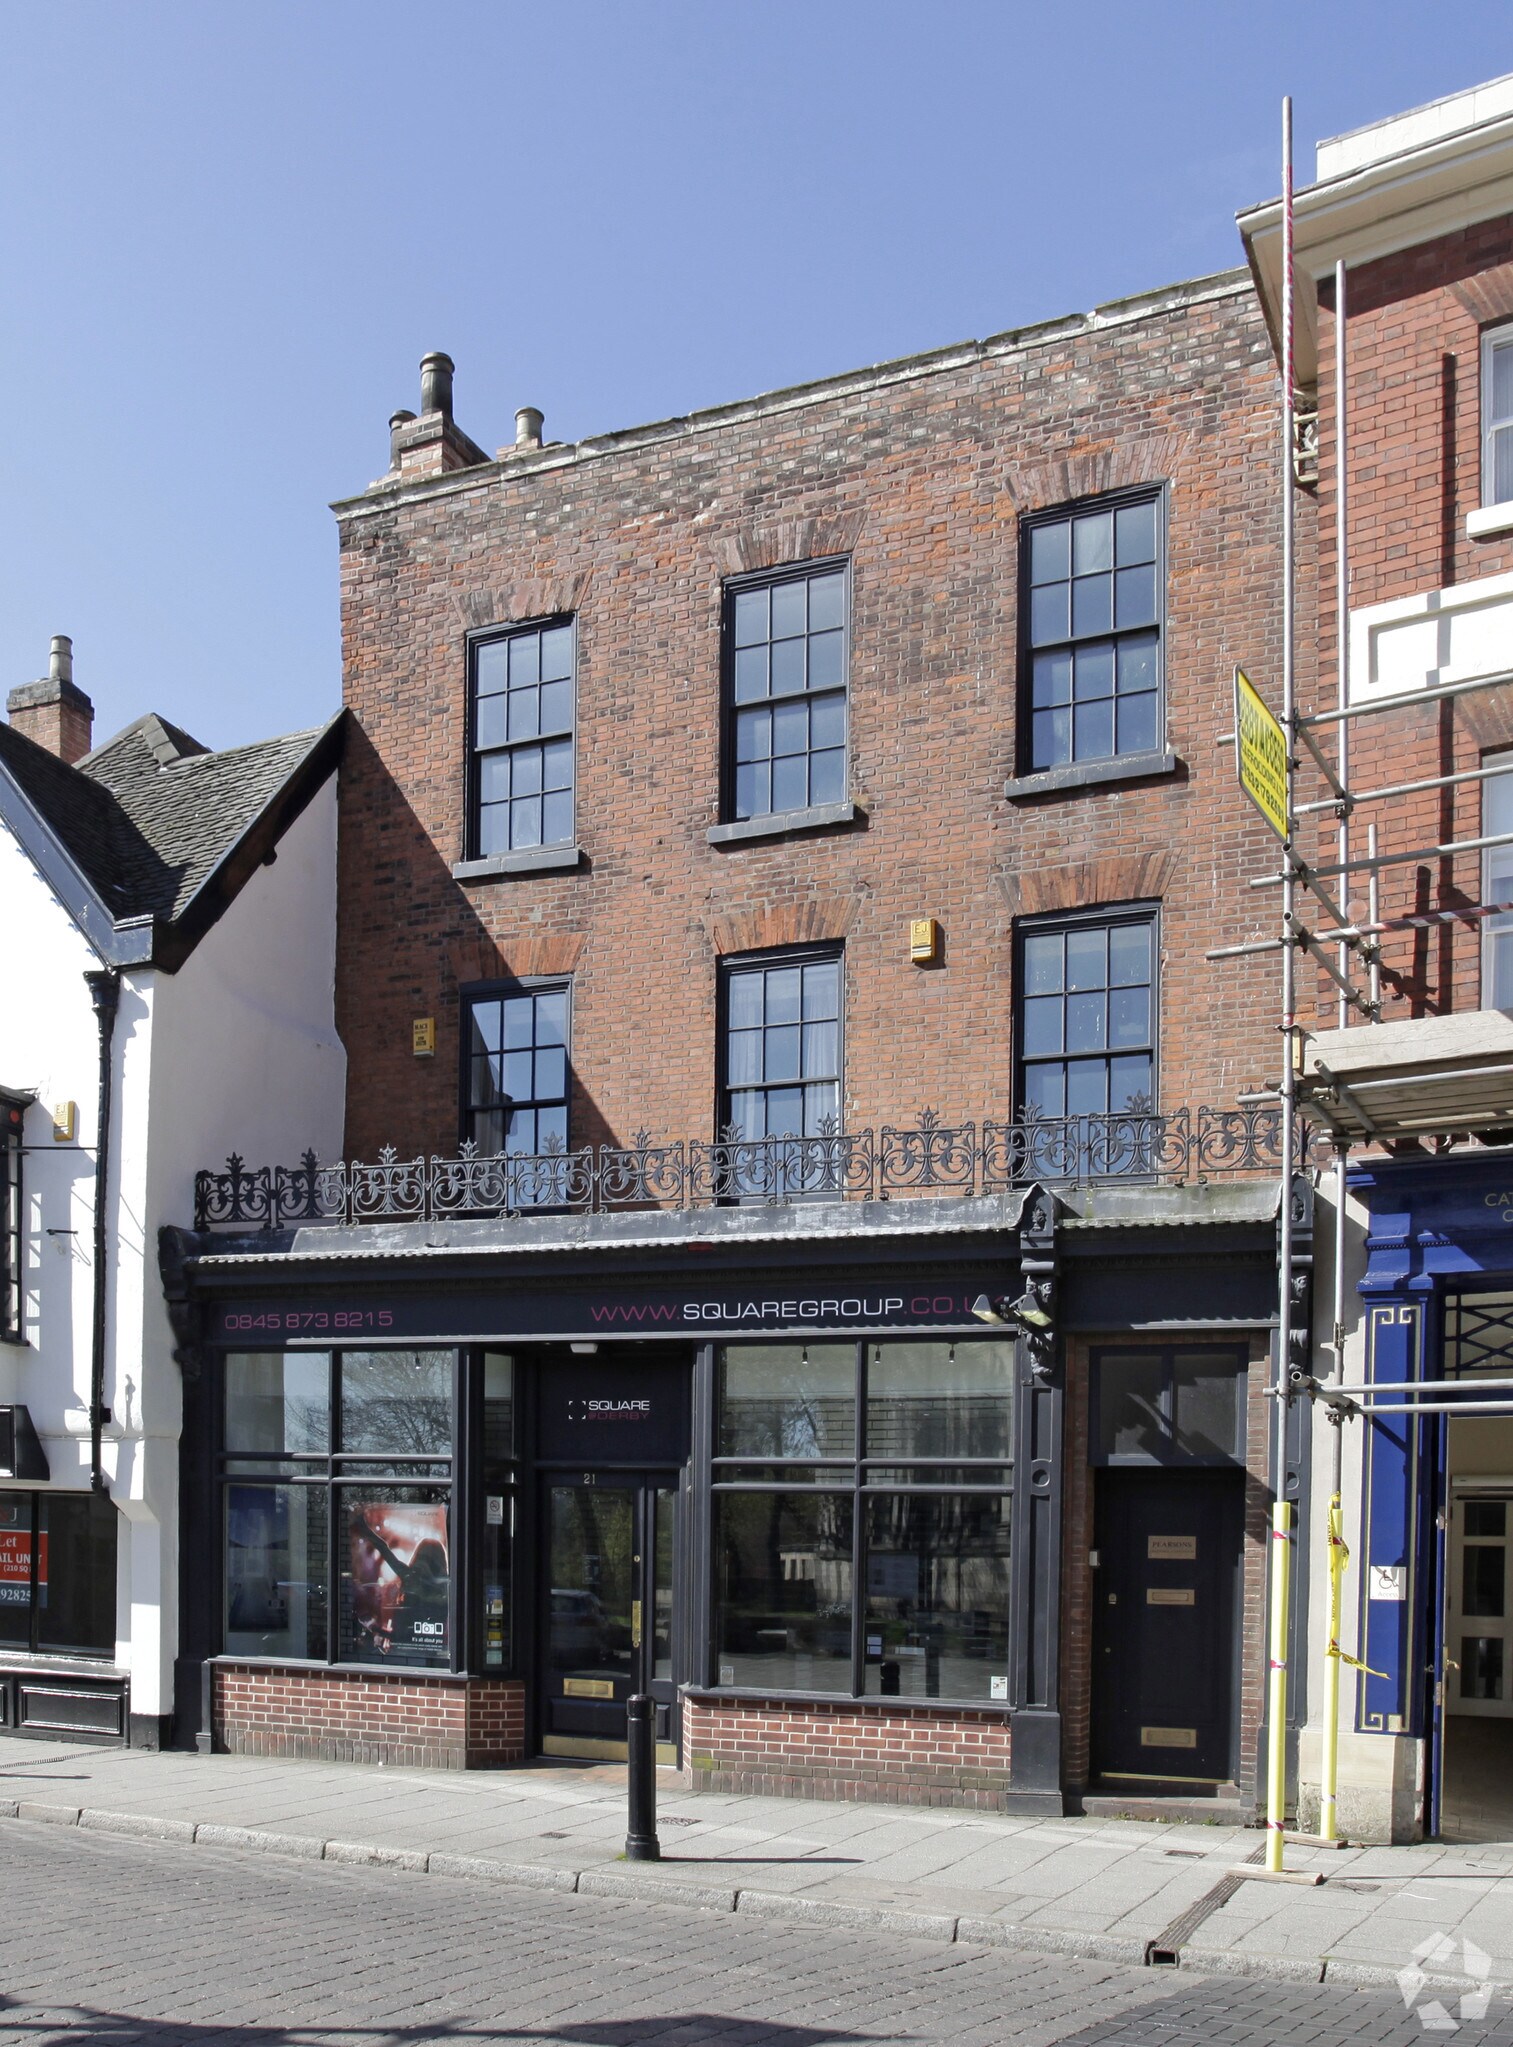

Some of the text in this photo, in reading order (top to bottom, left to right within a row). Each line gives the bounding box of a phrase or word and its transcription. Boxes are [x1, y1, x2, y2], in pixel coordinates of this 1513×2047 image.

[590, 1296, 1004, 1321] WWW.SQUAREGROUP.CO.U
[225, 1310, 394, 1330] 0845 873 8215
[588, 1400, 651, 1411] SQUARE
[583, 1473, 596, 1485] 21
[16, 1553, 42, 1565] UNT
